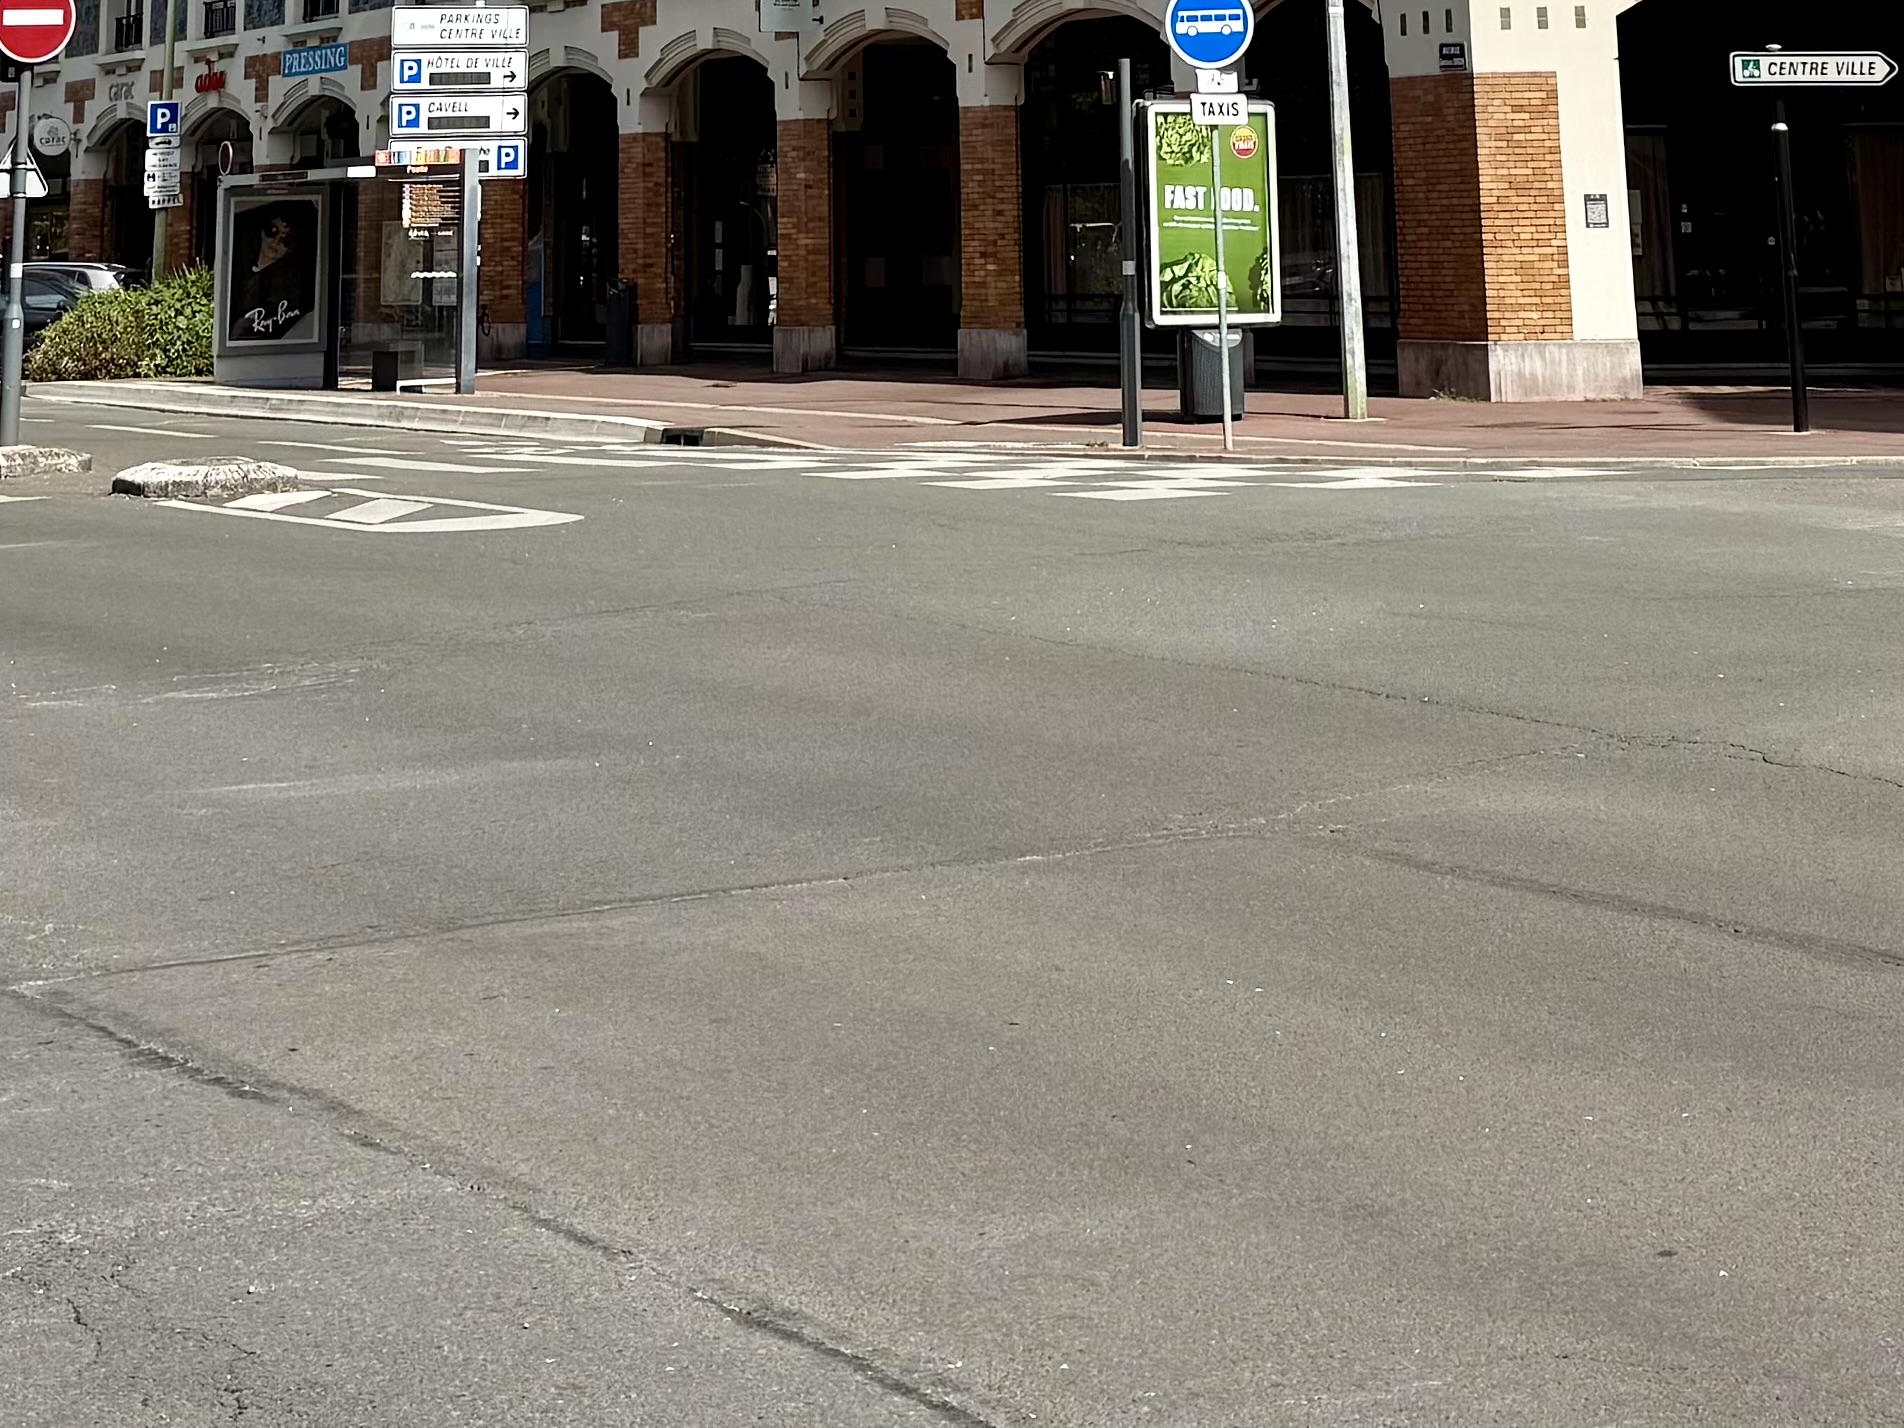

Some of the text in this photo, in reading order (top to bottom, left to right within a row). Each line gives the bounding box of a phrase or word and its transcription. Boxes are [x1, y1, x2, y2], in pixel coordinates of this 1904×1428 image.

[440, 14, 500, 24] PARKINGS
[440, 28, 521, 39] CENTRE VILLE
[285, 47, 345, 73] PRESSING
[427, 56, 513, 68] HÔTEL DE VILLE
[1768, 61, 1876, 76] CENTRE VILLE
[428, 102, 468, 113] CAVELL
[1201, 102, 1239, 117] TAXIS
[1164, 185, 1207, 210] FAST
[245, 300, 300, 332] Ray-Ban
